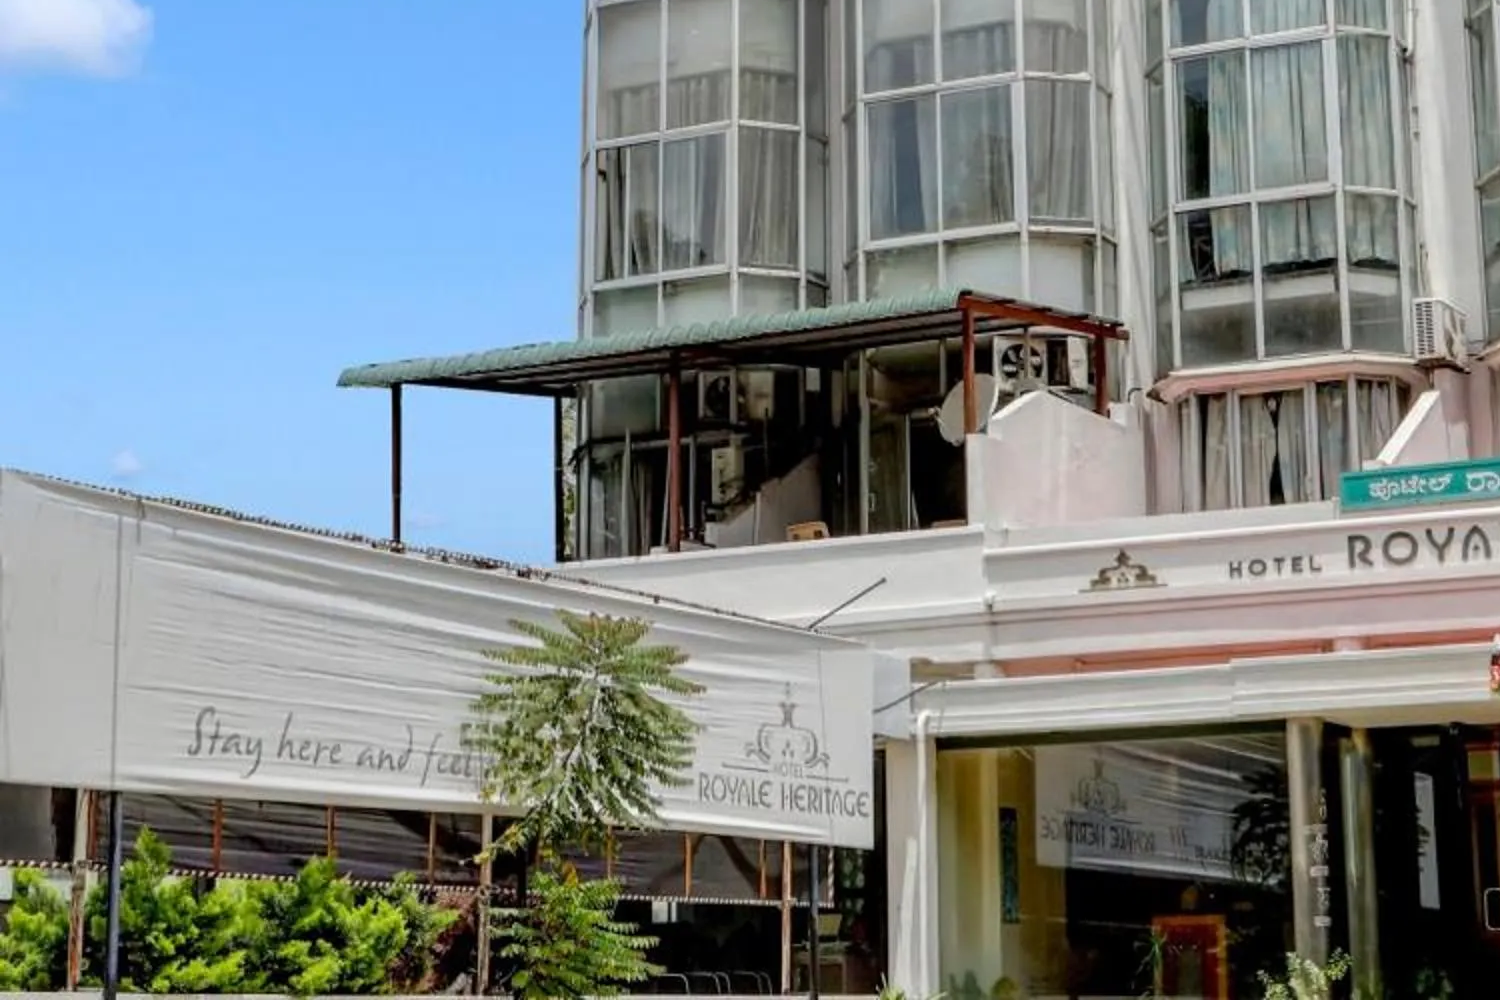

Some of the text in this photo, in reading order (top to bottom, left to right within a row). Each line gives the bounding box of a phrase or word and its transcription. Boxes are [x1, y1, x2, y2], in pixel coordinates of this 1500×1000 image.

[1228, 555, 1323, 580] HOTEL
[188, 706, 264, 779] Stay
[276, 711, 342, 767] here
[356, 725, 414, 772] and
[699, 771, 870, 818] ROYALE HERITAGE
